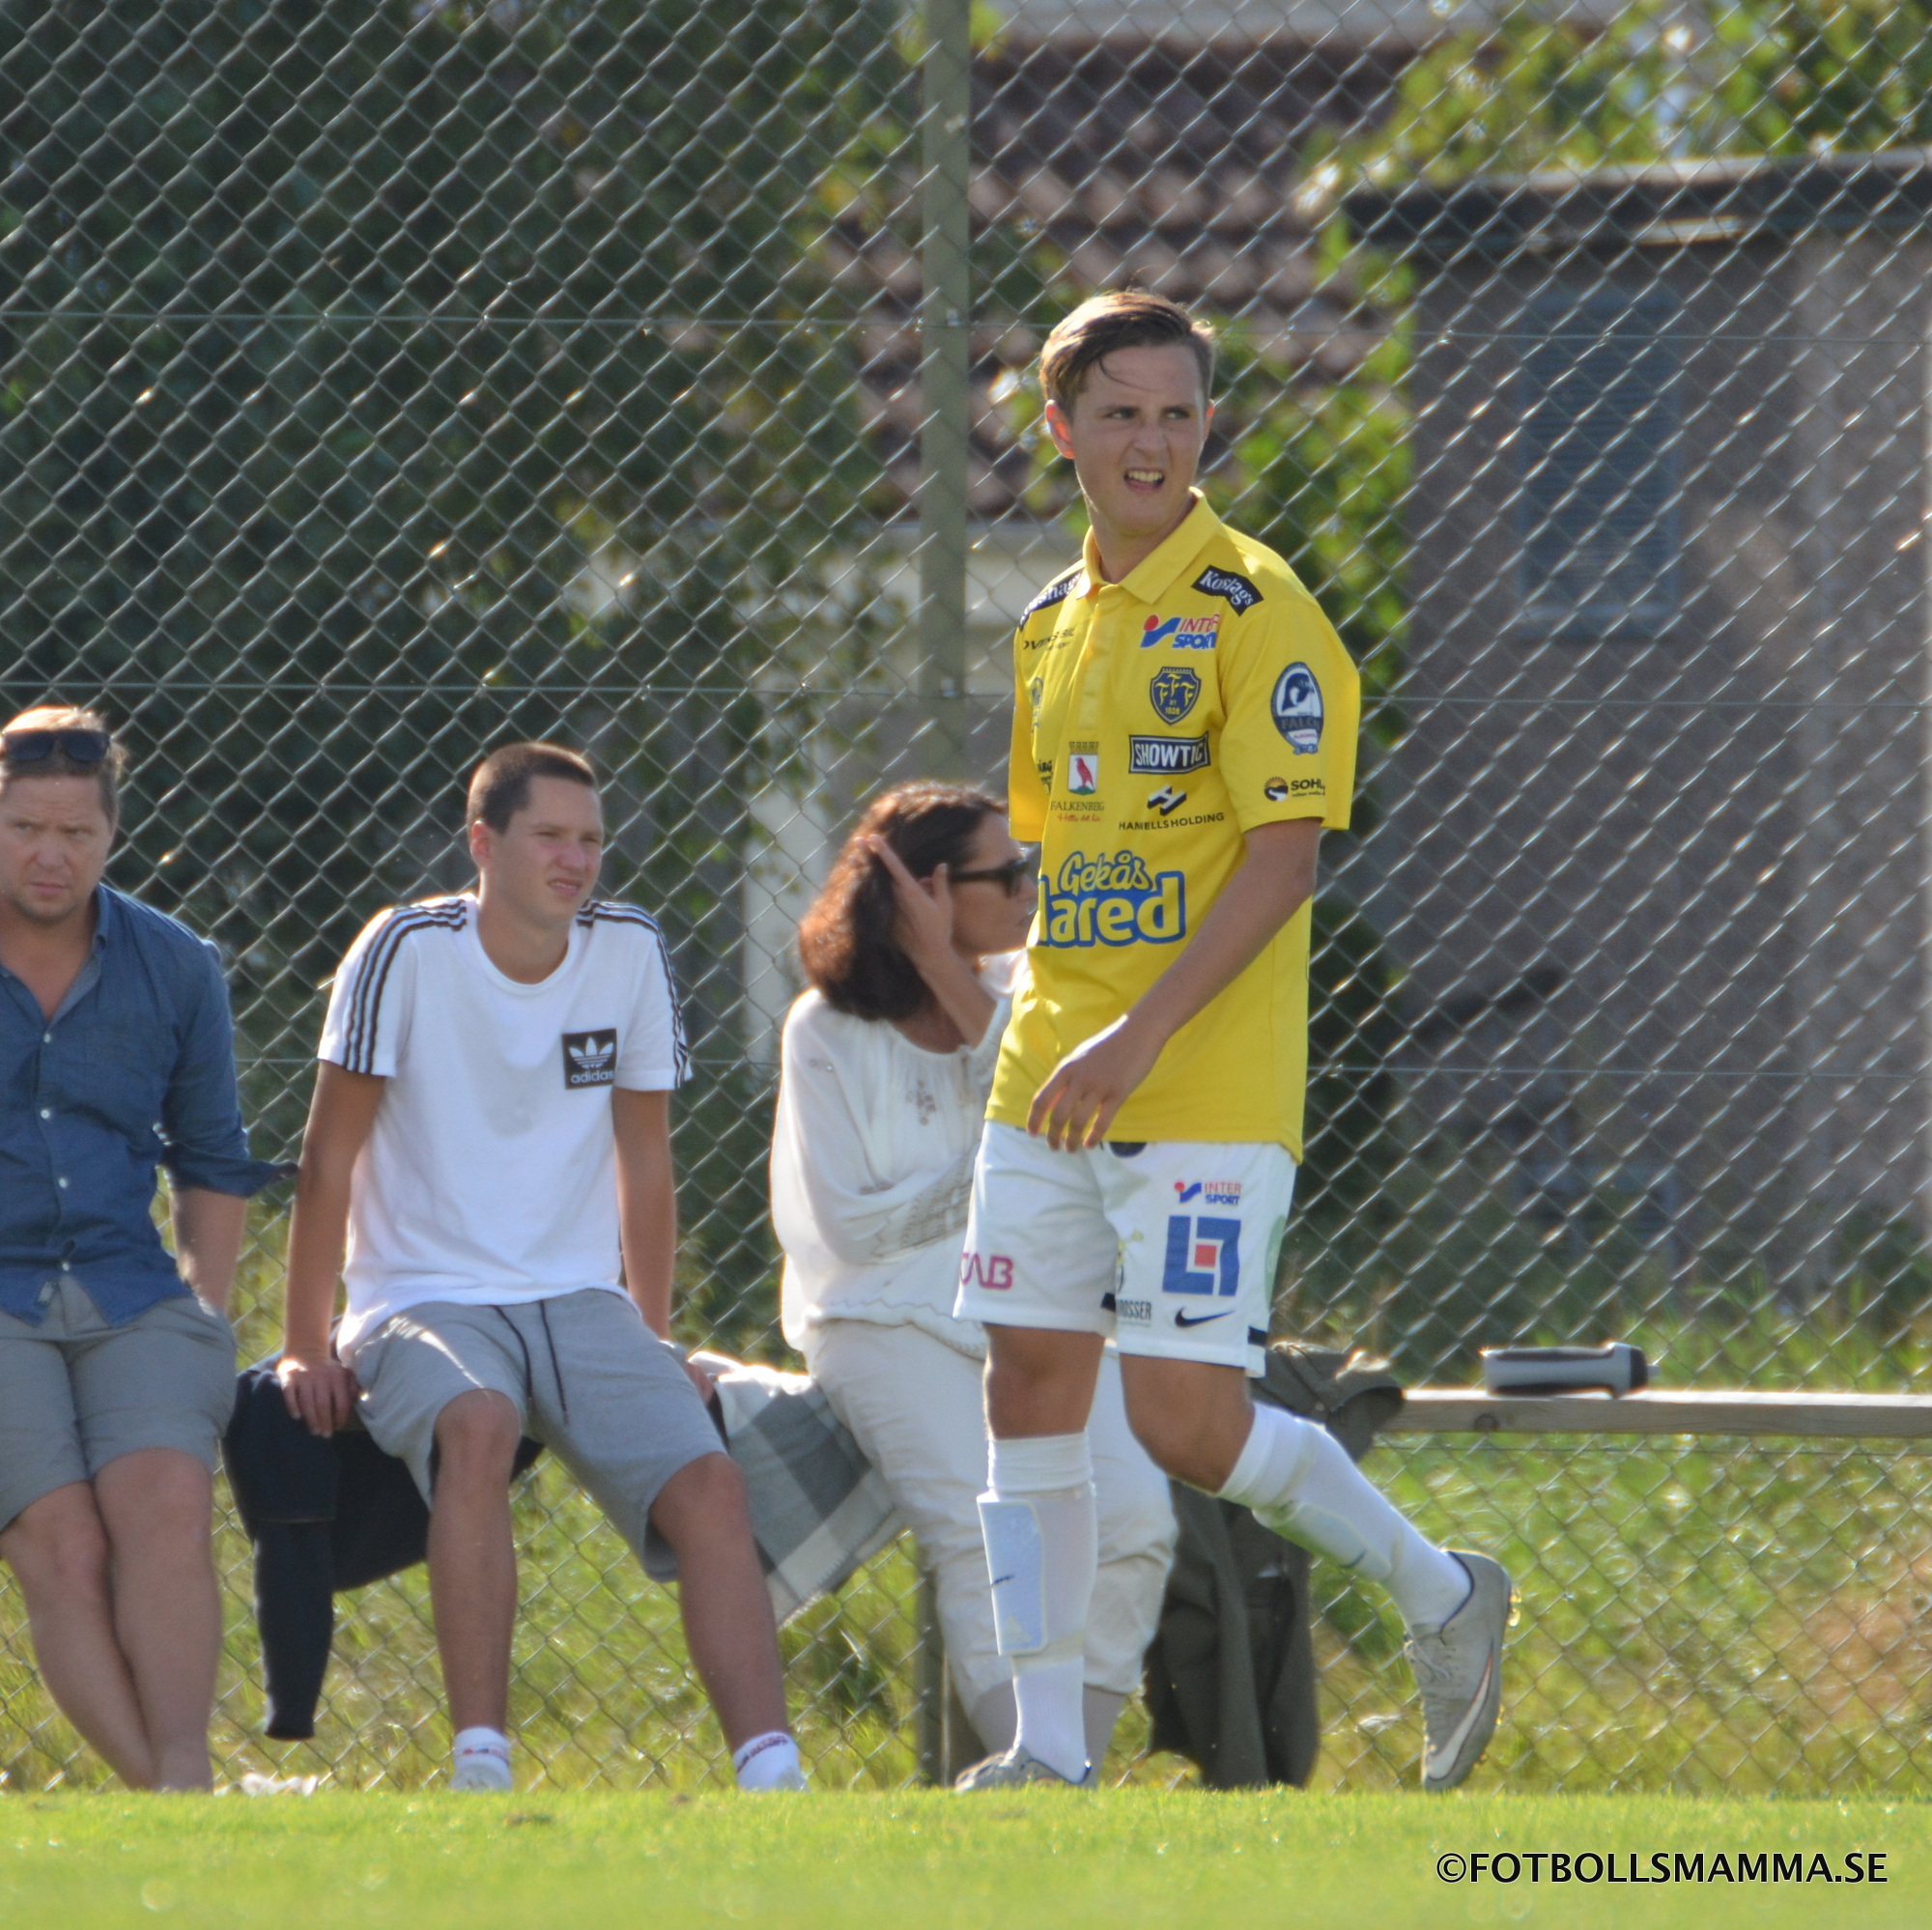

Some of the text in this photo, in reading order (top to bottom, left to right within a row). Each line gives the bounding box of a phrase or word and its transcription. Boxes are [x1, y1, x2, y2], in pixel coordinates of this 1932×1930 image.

[1171, 812, 1225, 828] HOLDING
[1058, 850, 1153, 897] Gekås
[570, 1069, 614, 1084] adidas
[1205, 1183, 1241, 1194] INTER
[1205, 1194, 1240, 1206] SPORT
